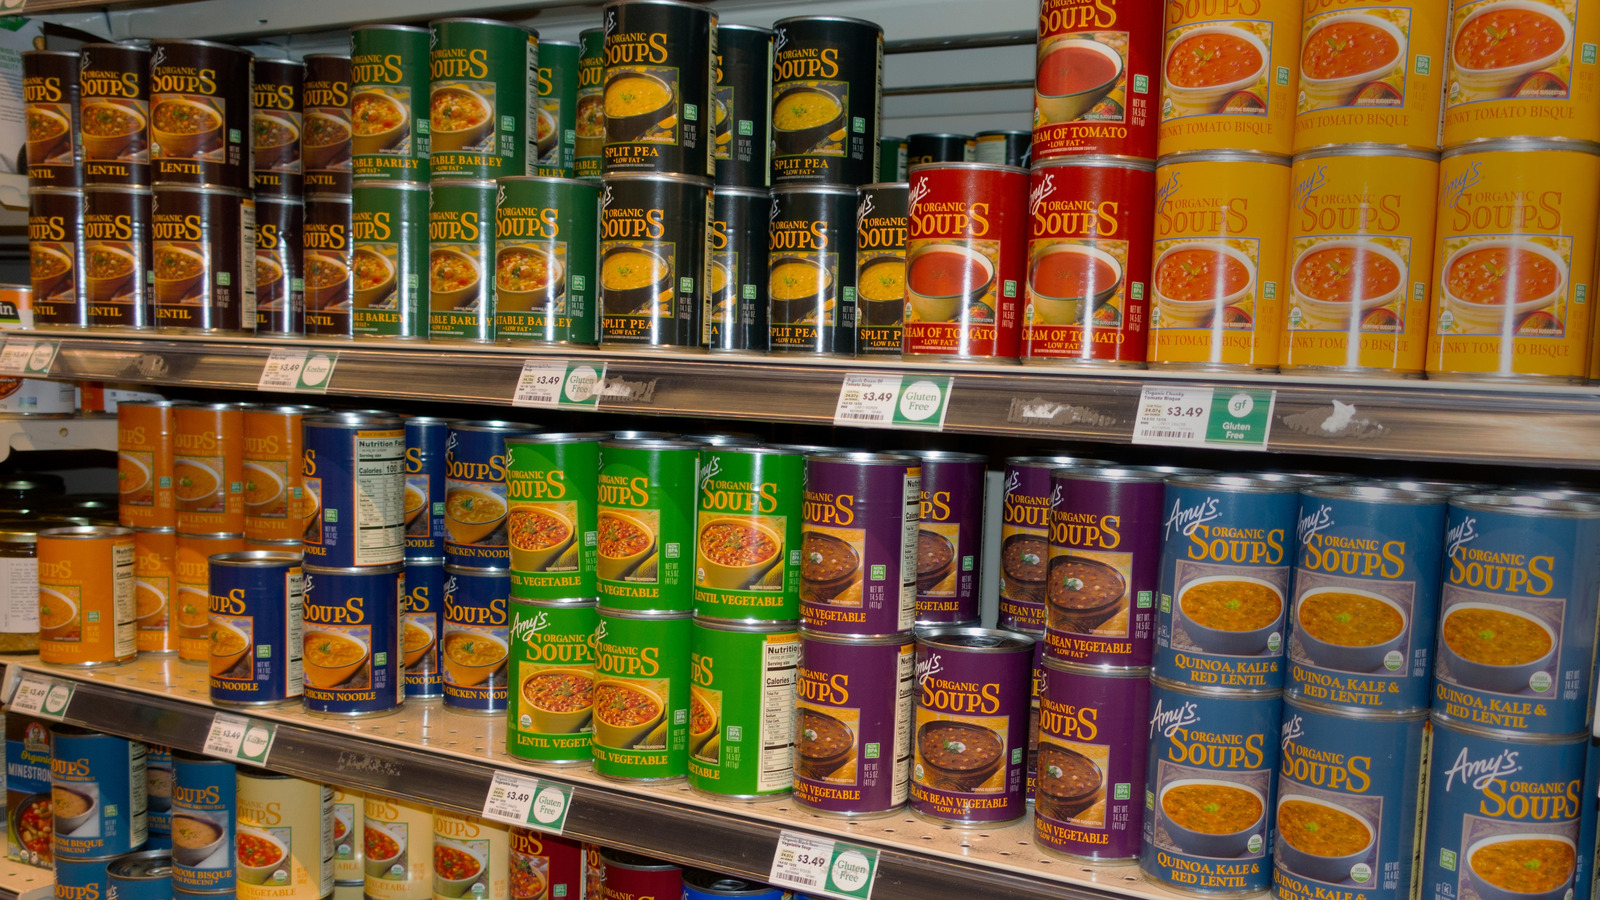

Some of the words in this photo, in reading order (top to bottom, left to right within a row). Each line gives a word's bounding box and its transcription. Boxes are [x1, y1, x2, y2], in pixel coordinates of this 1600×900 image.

[1040, 0, 1117, 36] SOUPS
[612, 33, 646, 43] ORGANIC
[435, 49, 466, 58] ORGANIC
[783, 49, 818, 59] ORGANIC
[774, 49, 838, 82] SOUPS
[87, 71, 119, 79] ORGANIC
[161, 67, 197, 78] ORGANIC
[1475, 108, 1527, 120] TOMATO
[1530, 106, 1574, 120] BISQUE
[1318, 114, 1364, 127] TOMATO
[1367, 113, 1409, 127] BISQUE
[1054, 128, 1068, 140] OF
[1072, 127, 1127, 140] TOMATO
[1186, 123, 1232, 135] TOMATO
[1235, 123, 1272, 135] BISQUE
[606, 147, 629, 157] SPLIT
[634, 147, 659, 157] PEA
[376, 156, 419, 169] BARLEY
[459, 155, 502, 167] BARLEY
[775, 159, 800, 169] SPLIT
[804, 159, 829, 169] PEA
[87, 164, 128, 177] LENTIL
[160, 162, 204, 175] LENTIL
[1475, 191, 1534, 202] ORGANIC
[924, 202, 966, 212] ORGANIC
[1049, 201, 1094, 210] ORGANIC
[1175, 198, 1223, 209] ORGANIC
[503, 208, 538, 217] ORGANIC
[609, 209, 643, 217] ORGANIC
[1160, 198, 1247, 235] SOUPS
[1302, 195, 1401, 232] SOUPS
[1453, 191, 1562, 232] SOUPS
[776, 220, 808, 229] ORGANIC
[870, 217, 907, 227] ORGANIC
[911, 202, 989, 237] SOUPS
[1034, 201, 1118, 236] SOUPS
[88, 307, 122, 317] LENTIL
[156, 308, 191, 319] LENTIL
[602, 319, 626, 329] SPLIT
[797, 328, 817, 338] PEA
[861, 329, 888, 339] SPLIT
[928, 329, 941, 338] OF
[1052, 330, 1066, 340] OF
[1372, 339, 1408, 353] BISQUE
[1530, 343, 1569, 358] BISQUE
[281, 363, 299, 372] $3.49
[306, 366, 327, 374] Kosher
[537, 376, 559, 385] $3.49
[570, 376, 593, 384] Gluten
[571, 385, 588, 393] Free
[863, 392, 892, 401] $3.49
[906, 392, 936, 401] Gluten
[909, 402, 929, 410] Free
[1234, 400, 1246, 411] gf
[1167, 407, 1203, 417] $3.49
[1223, 422, 1250, 431] Gluten
[1226, 431, 1244, 439] Free
[359, 440, 393, 448] Nutrition
[387, 465, 397, 473] 100
[512, 471, 544, 479] ORGANIC
[703, 480, 777, 513] SOUPS
[1058, 512, 1097, 523] ORGANIC
[1165, 497, 1219, 541] Amy's
[1212, 527, 1264, 540] ORGANIC
[1188, 525, 1284, 564] SOUPS
[1325, 535, 1379, 550] ORGANIC
[1305, 533, 1406, 579] SOUPS
[1469, 548, 1525, 566] ORGANIC
[1450, 546, 1554, 596] SOUPS
[527, 576, 581, 587] VEGETABLE
[604, 585, 659, 598] VEGETABLE
[722, 593, 783, 607] VEGETABLE
[815, 609, 866, 623] VEGETABLE
[1008, 606, 1030, 617] BEAN
[510, 612, 548, 645] Amy's
[544, 634, 584, 642] ORGANIC
[603, 644, 638, 656] ORGANIC
[1052, 636, 1074, 649] BEAN
[1076, 639, 1132, 654] VEGETABLE
[1175, 654, 1237, 674] QUINOA,
[1237, 660, 1269, 672] KALE
[1270, 662, 1278, 672] &
[766, 678, 790, 686] Calories
[1191, 670, 1218, 684] RED
[1221, 672, 1266, 686] LENTIL
[1293, 666, 1345, 690] QUINOA,
[1347, 678, 1385, 693] KALE
[1388, 682, 1399, 693] &
[222, 681, 259, 692] NOODLE
[936, 680, 978, 692] ORGANIC
[30, 689, 45, 698] $3.49
[336, 691, 376, 701] NOODLE
[922, 676, 1000, 714] SOUPS
[1304, 684, 1328, 700] RED
[1331, 688, 1382, 706] LENTIL
[1437, 684, 1487, 711] QUINOA,
[1490, 699, 1531, 716] KALE
[1535, 704, 1546, 716] &
[1150, 699, 1197, 739] Amy's
[1446, 703, 1470, 719] RED
[1472, 708, 1528, 728] LENTIL
[223, 730, 240, 740] $3.49
[517, 734, 550, 748] LENTIL
[1190, 730, 1243, 744] ORGANIC
[1169, 727, 1264, 768] SOUPS
[608, 753, 667, 766] VEGETABLE
[1296, 747, 1344, 765] ORGANIC
[8, 762, 51, 781] MINESTRON
[1282, 740, 1371, 793] SOUPS
[1445, 747, 1519, 792] Amy's
[810, 785, 860, 800] VEGETABLE
[1510, 782, 1565, 794] ORGANIC
[507, 792, 529, 802] $3.49
[539, 796, 561, 807] Gluten
[929, 795, 954, 807] BEAN
[956, 798, 1008, 809] VEGETABLE
[1480, 778, 1580, 819] SOUPS
[540, 806, 555, 815] Free
[937, 806, 951, 814] LOW
[953, 807, 966, 815] FAT
[1054, 824, 1109, 845] VEGETABLE
[73, 840, 103, 848] BISQUE
[798, 854, 825, 867] $3.49
[838, 860, 865, 873] Gluten
[1157, 852, 1213, 875] QUINOA,
[1216, 862, 1249, 875] KALE
[1251, 863, 1259, 873] &
[198, 871, 232, 880] BISQUE
[840, 871, 858, 882] Free
[1171, 869, 1197, 885] RED
[1200, 872, 1246, 887] LENTIL
